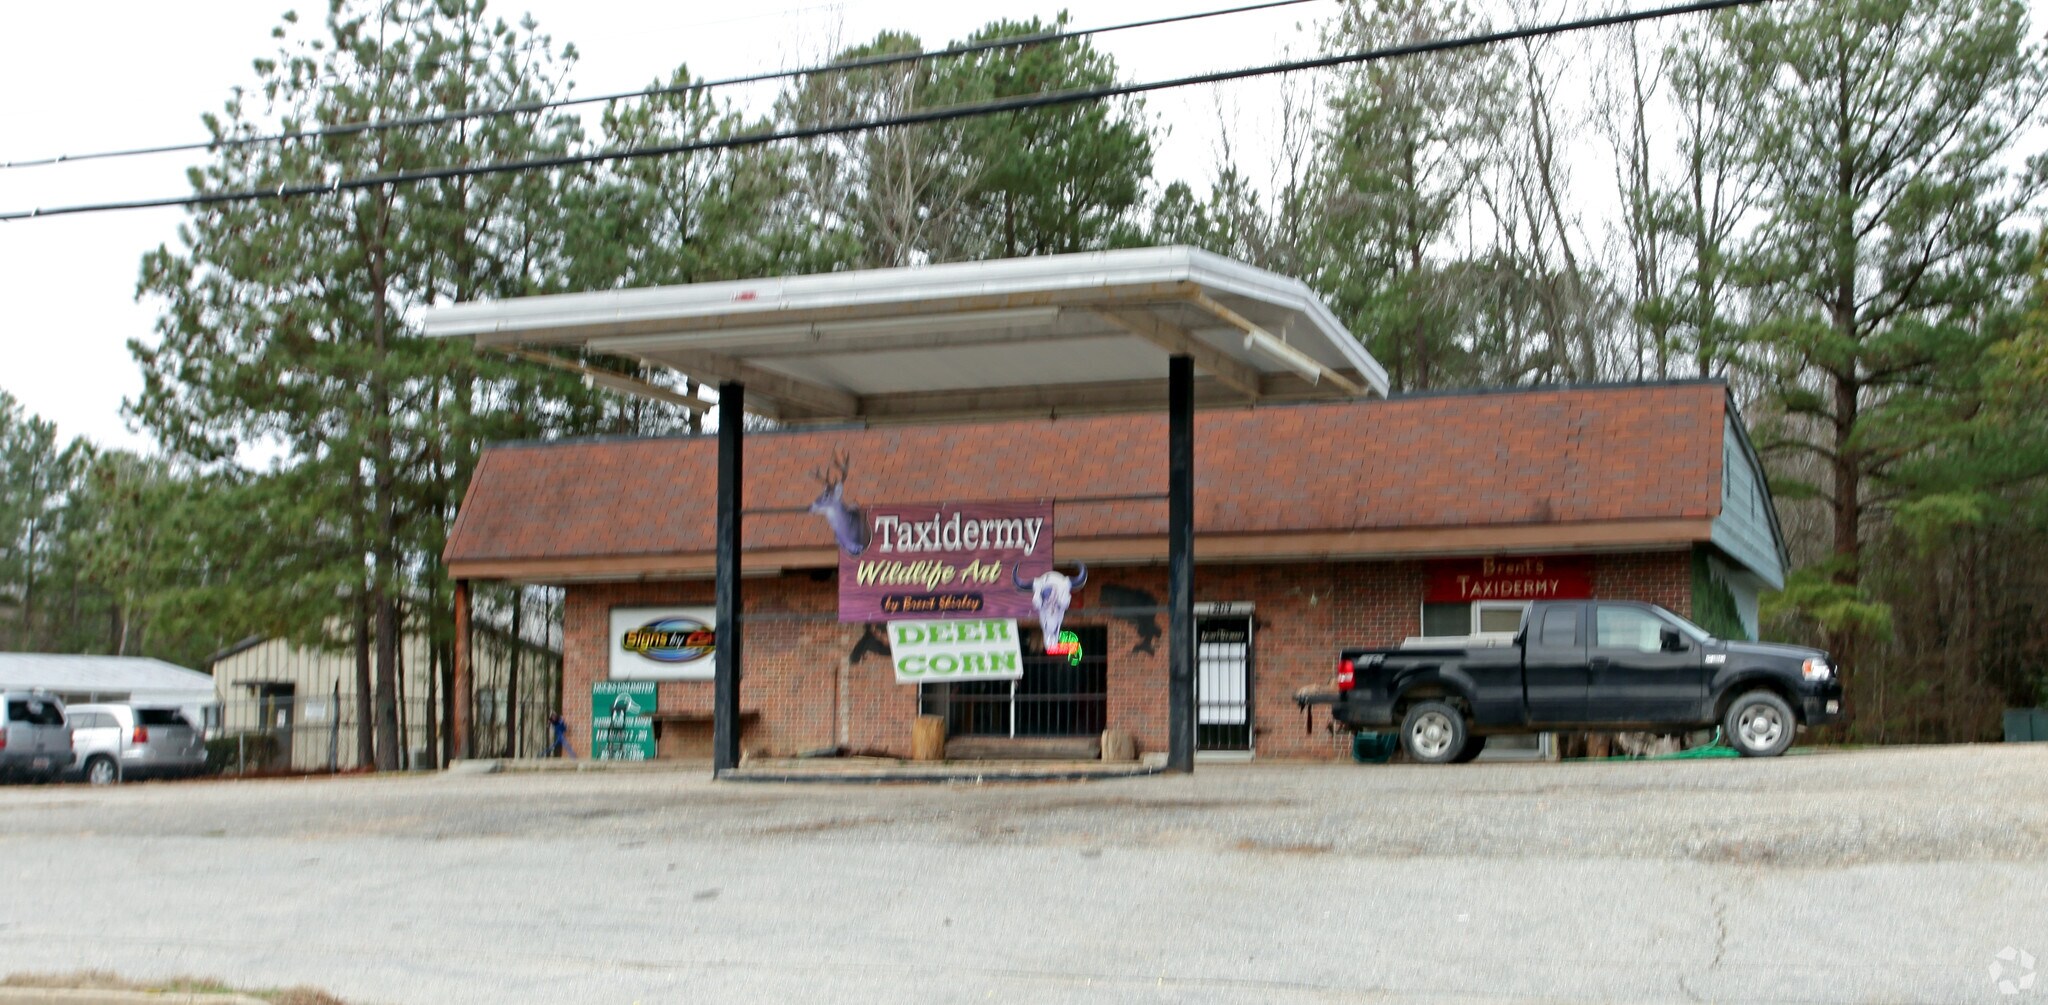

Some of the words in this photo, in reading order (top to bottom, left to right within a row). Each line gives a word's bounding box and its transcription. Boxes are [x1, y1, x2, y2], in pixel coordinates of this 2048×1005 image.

[874, 511, 1043, 556] Taxidermy
[856, 559, 956, 592] Wildlife
[960, 558, 1002, 585] Art
[1456, 575, 1560, 598] TAXIDERMY
[884, 595, 899, 615] by
[625, 630, 668, 652] Signs
[668, 630, 685, 650] by
[895, 619, 1011, 645] DEER
[897, 651, 1017, 676] CORN
